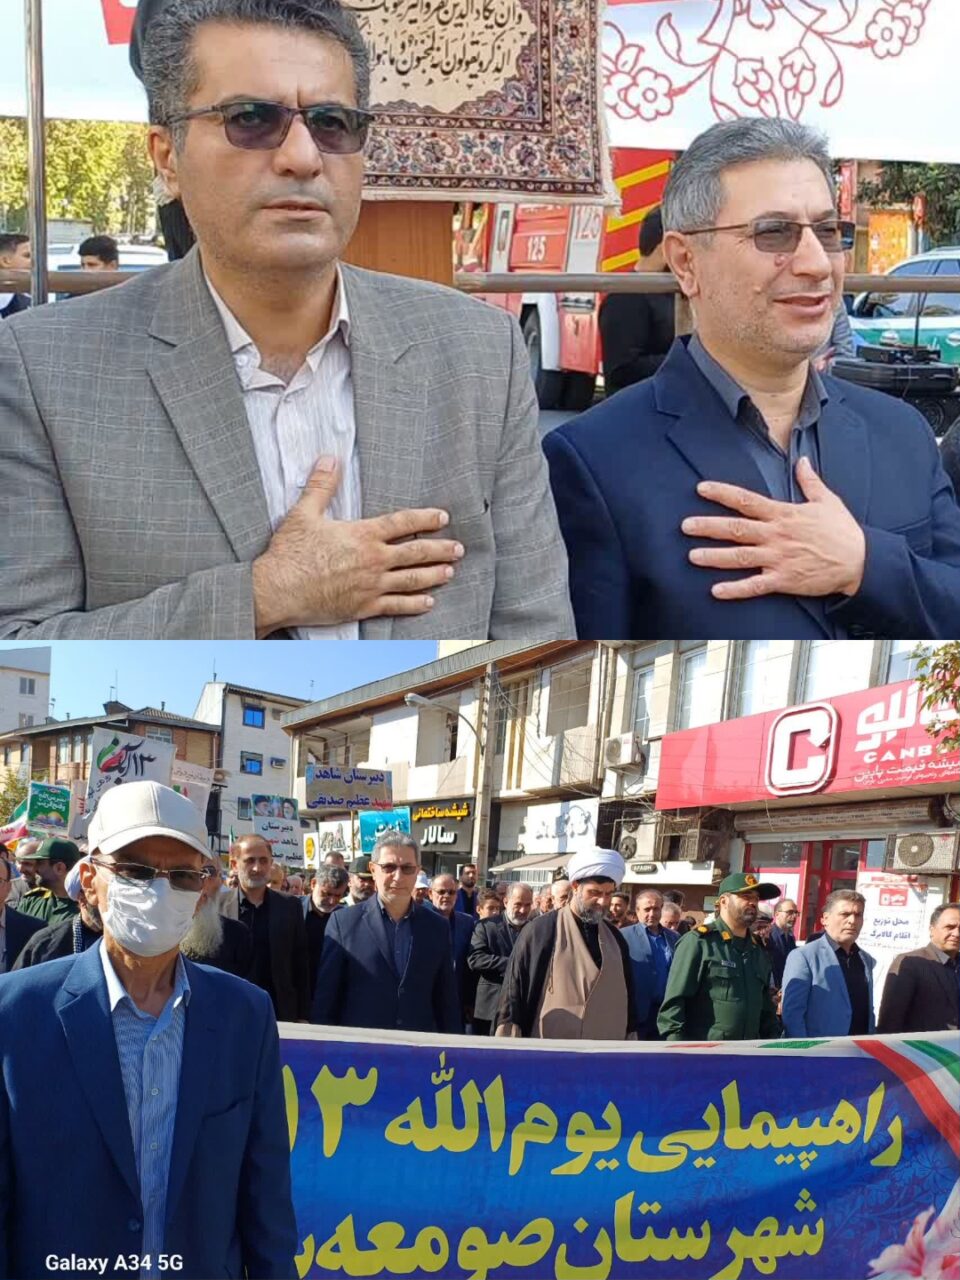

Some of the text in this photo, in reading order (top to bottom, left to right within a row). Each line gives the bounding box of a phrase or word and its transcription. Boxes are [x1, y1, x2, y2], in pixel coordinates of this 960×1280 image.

[527, 236, 547, 261] 125
[315, 767, 385, 785] دبیرستان شاهد
[854, 764, 884, 783] پایین
[887, 762, 926, 775] قیمت
[347, 795, 370, 809] عظیم
[417, 825, 457, 847] سالار
[386, 1050, 508, 1160] الله
[513, 1097, 623, 1177] یوم
[632, 1081, 903, 1170] راهپیمایی
[545, 1188, 827, 1280] شهرستان
